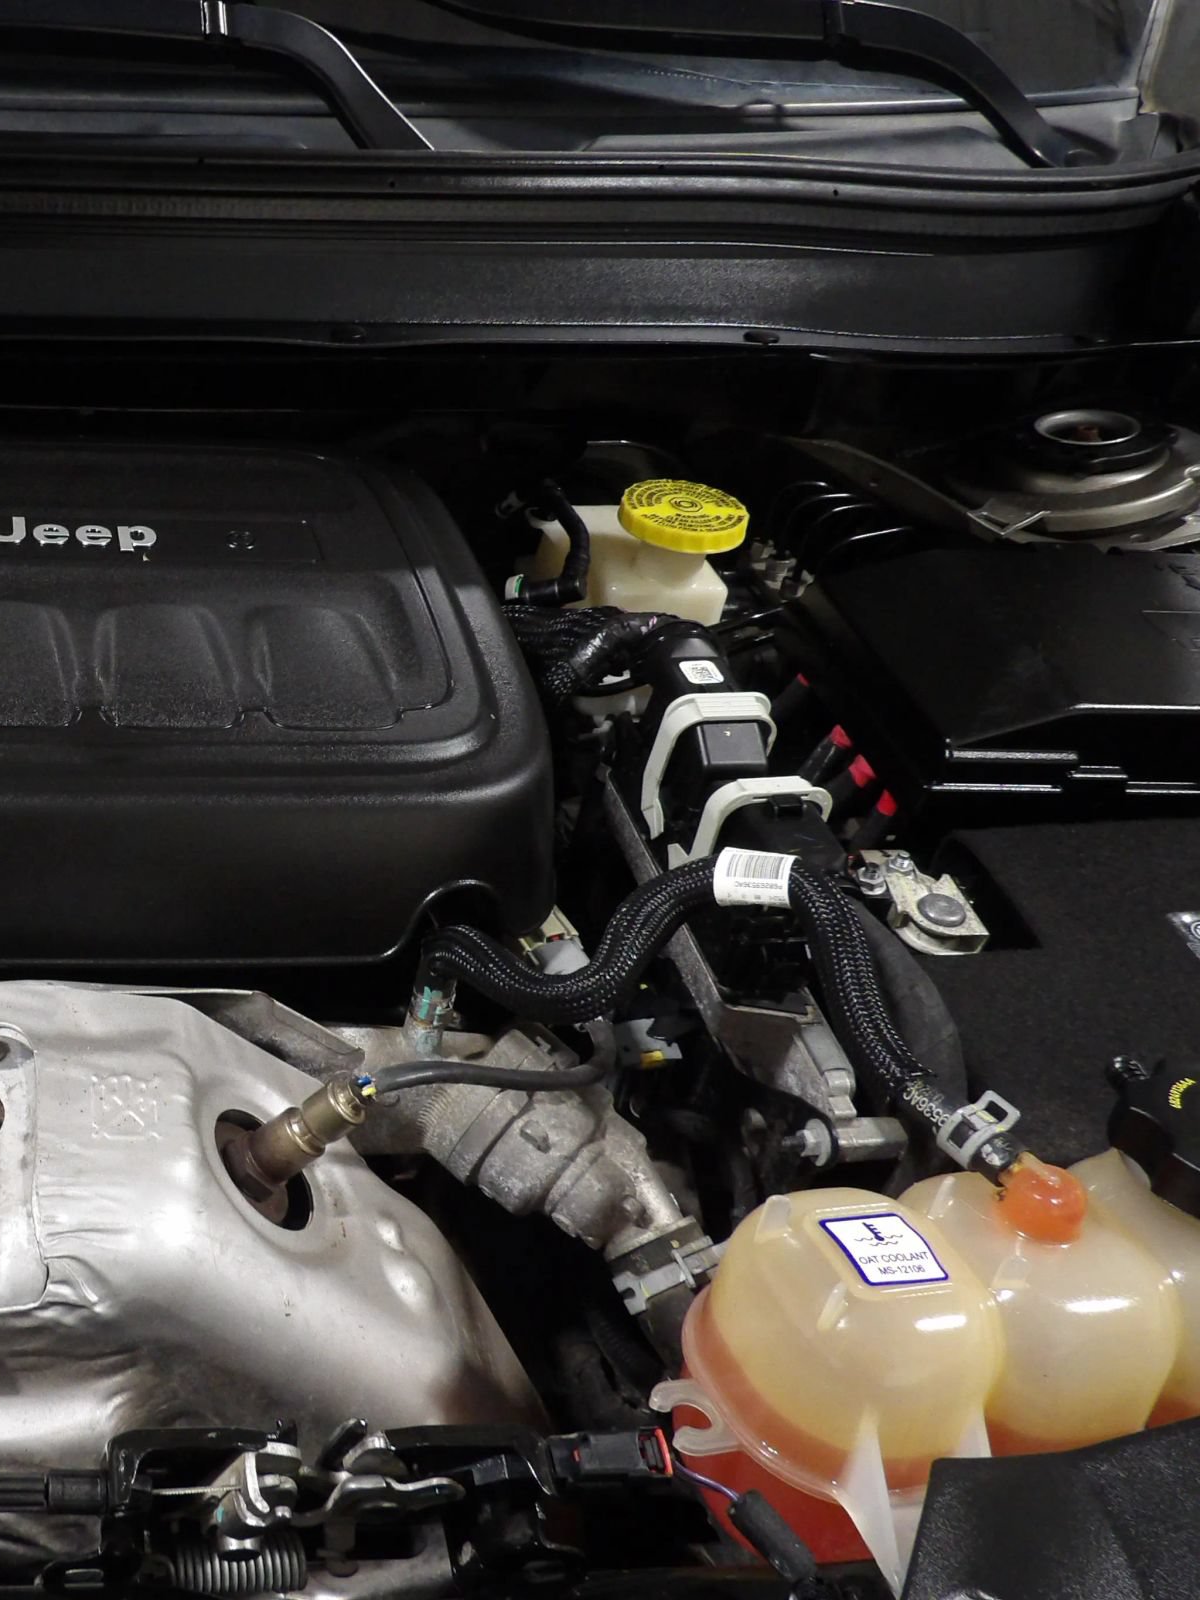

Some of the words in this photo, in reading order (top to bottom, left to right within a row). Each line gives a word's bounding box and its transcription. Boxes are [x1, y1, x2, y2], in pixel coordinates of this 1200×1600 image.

[858, 1255, 880, 1265] OAT
[881, 1251, 929, 1263] COOLANT
[877, 1264, 926, 1275] MS-12106
